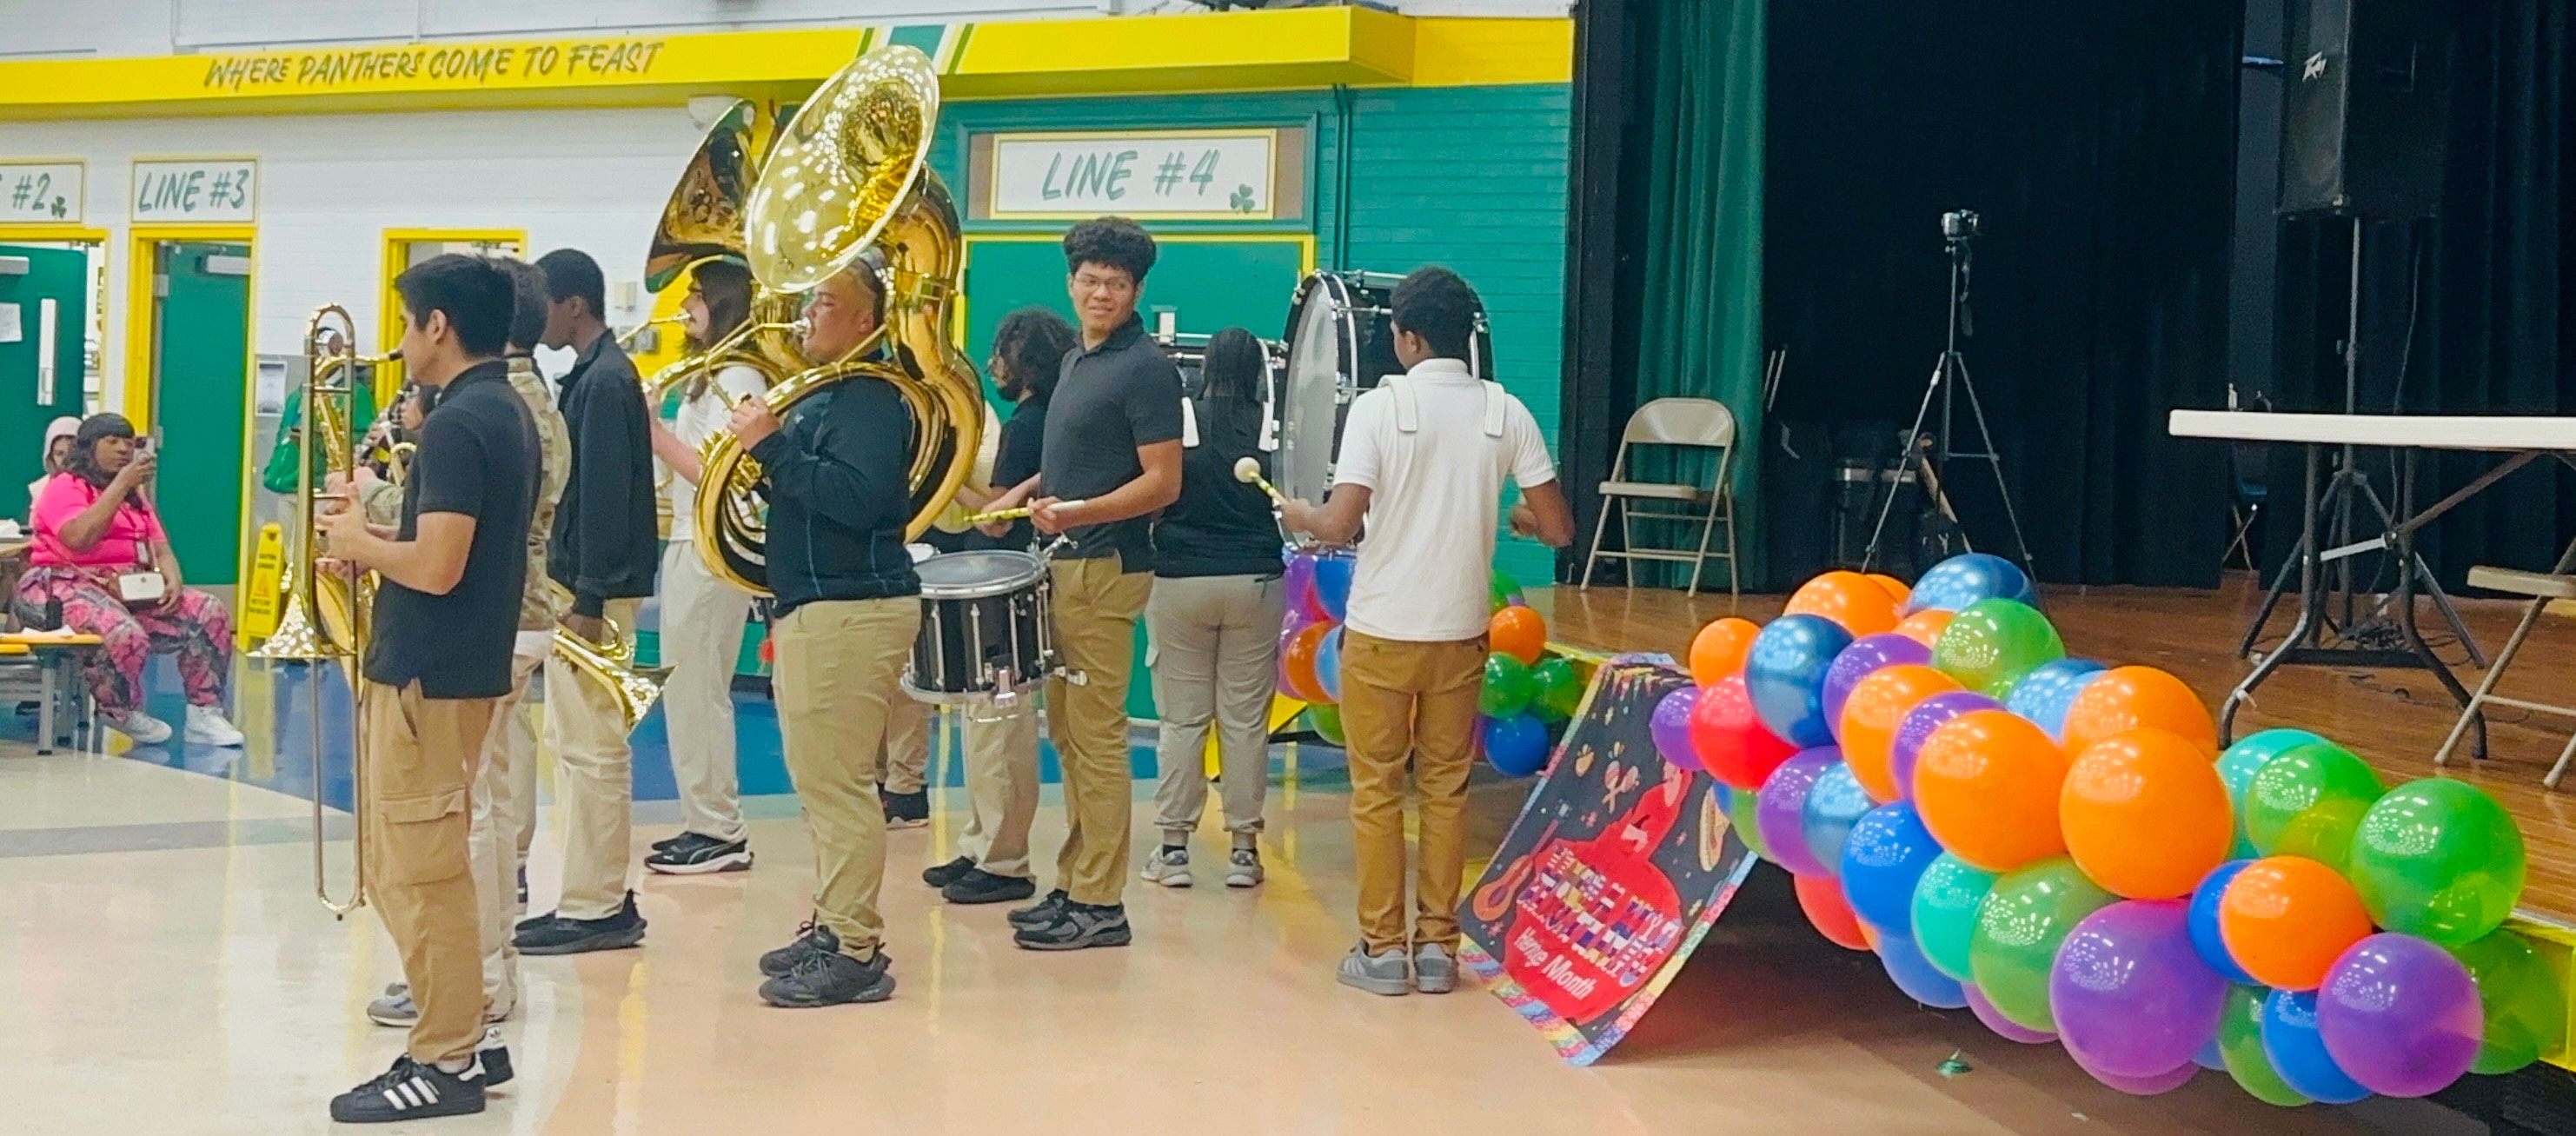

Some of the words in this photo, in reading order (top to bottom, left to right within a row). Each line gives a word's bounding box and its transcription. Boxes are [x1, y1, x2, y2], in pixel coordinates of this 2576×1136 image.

[203, 57, 292, 91] WHERE
[297, 50, 425, 86] PANTHERS
[428, 46, 515, 83] COME
[523, 46, 560, 77] TO
[568, 42, 665, 76] FEAST
[12, 172, 51, 211] #2
[138, 169, 205, 213] LINE
[209, 169, 250, 209] #3
[1042, 149, 1138, 202] LINE
[1153, 149, 1221, 197] #4
[1541, 953, 1598, 1001] Month
